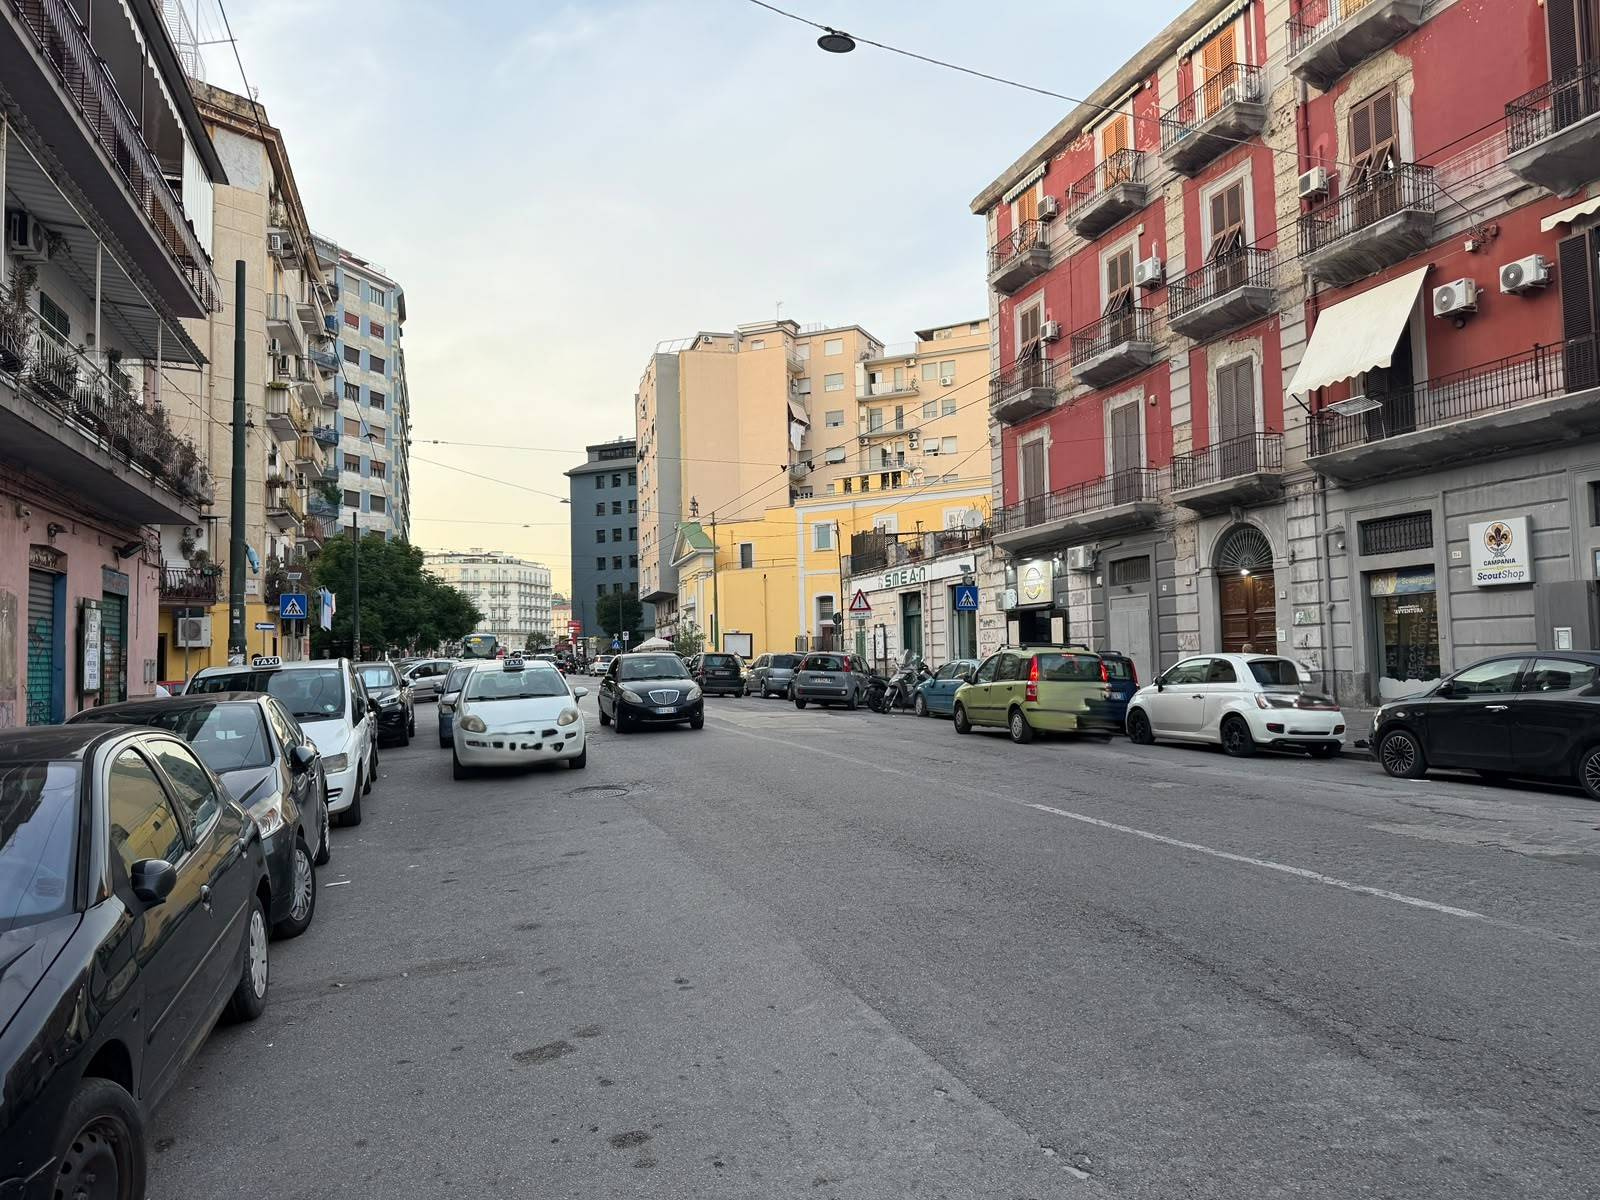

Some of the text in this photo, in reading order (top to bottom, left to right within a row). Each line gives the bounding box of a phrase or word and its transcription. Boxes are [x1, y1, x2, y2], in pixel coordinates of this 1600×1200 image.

[1483, 558, 1516, 566] CAMPANIA
[1476, 569, 1525, 581] ScoutShop
[254, 658, 278, 666] TAXI
